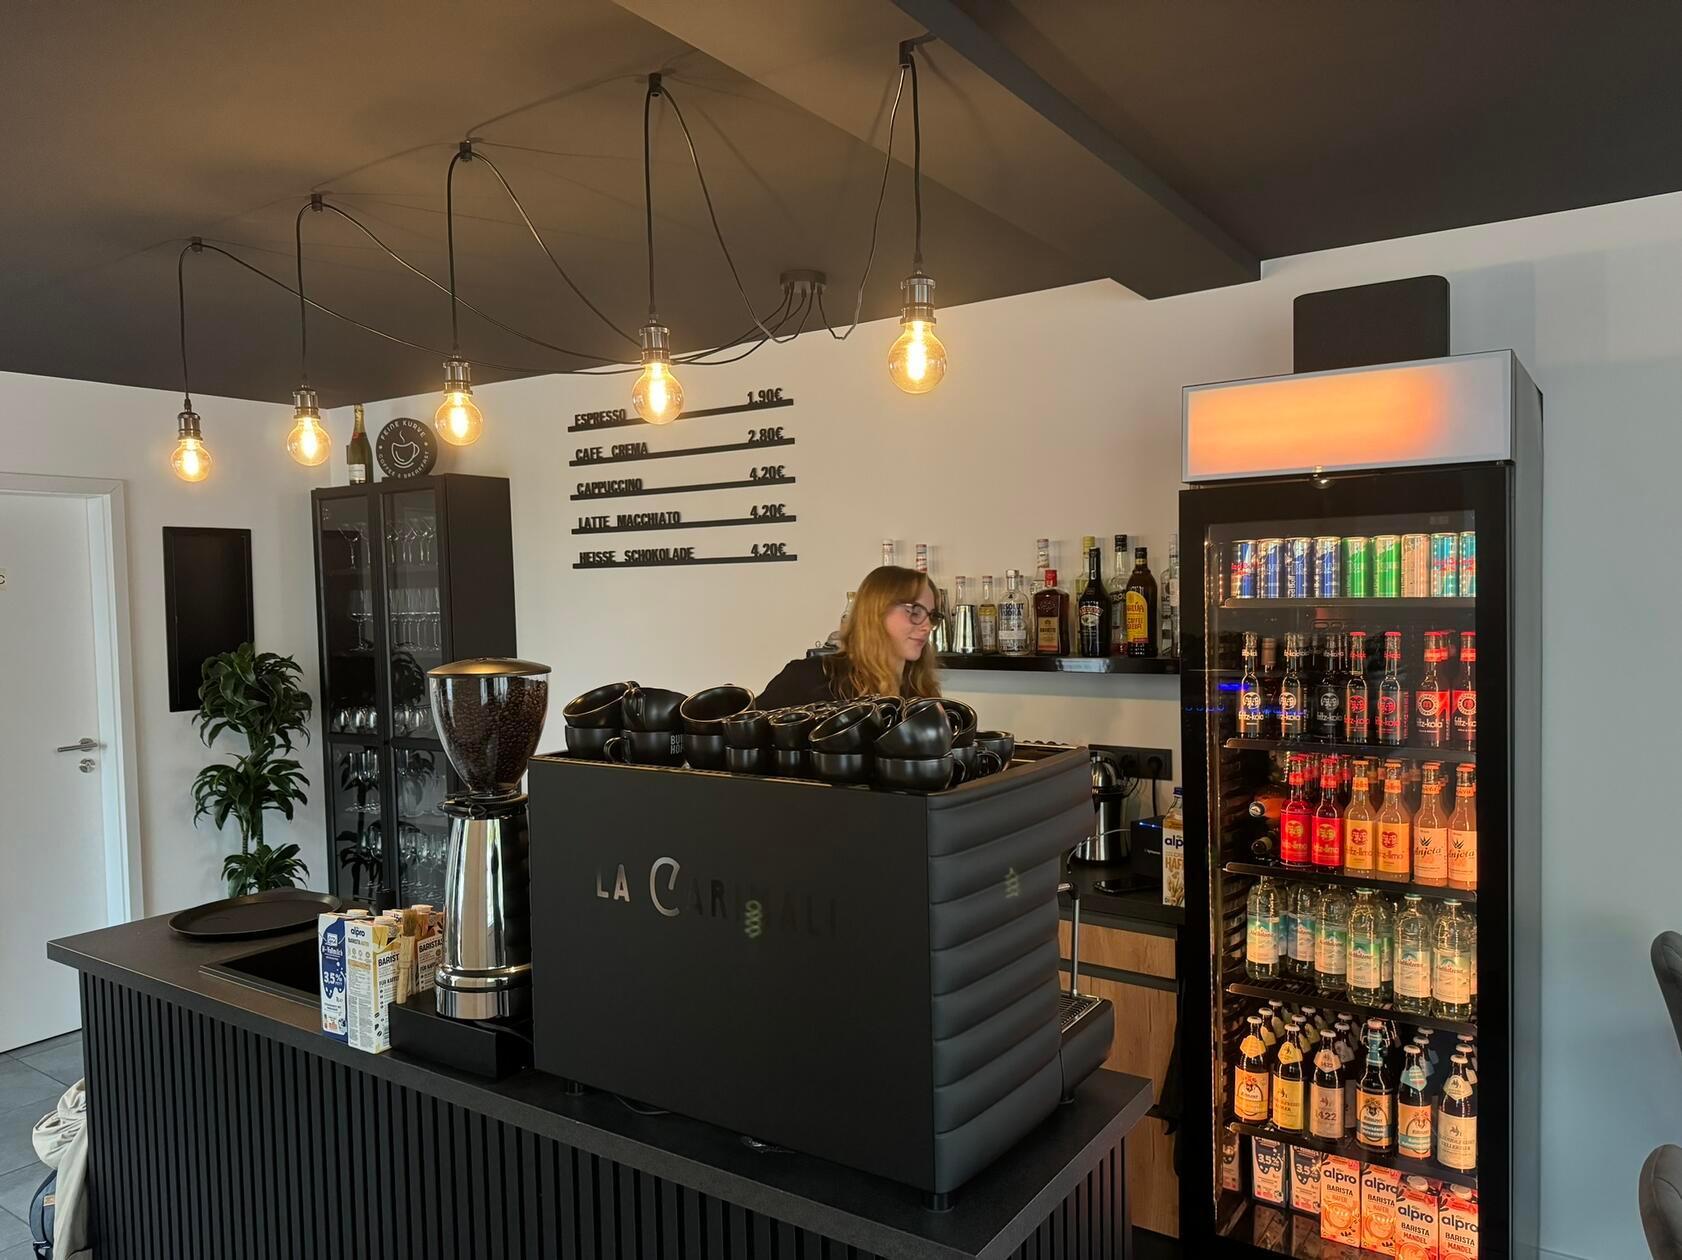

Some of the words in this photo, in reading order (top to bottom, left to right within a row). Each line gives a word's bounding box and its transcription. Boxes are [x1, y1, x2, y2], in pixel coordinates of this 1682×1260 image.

[575, 408, 627, 426] ESPRESSO
[748, 388, 784, 404] 1.90€
[381, 421, 399, 440] FEINE
[403, 420, 426, 438] KURVE
[575, 447, 603, 460] CAFE
[611, 442, 648, 458] CREMA
[748, 426, 784, 443] 2.80€
[576, 478, 643, 495] CAPPUCCINO
[749, 465, 785, 481] 4.20€
[578, 515, 610, 529] LATTE
[617, 511, 681, 527] MACCHIATO
[750, 503, 786, 519] 4.20€
[579, 550, 616, 564] HEISSE
[624, 547, 695, 562] SCHOKOLADE
[750, 542, 786, 557] 4.20€
[596, 863, 631, 903] LA
[350, 927, 365, 937] alpro
[1323, 1168, 1357, 1184] alpro
[1326, 1184, 1354, 1196] BARISTA
[1364, 1177, 1399, 1195] alpro
[1367, 1194, 1395, 1207] BARISTA
[1397, 1205, 1434, 1223] alpro
[1401, 1222, 1430, 1236] BARISTA
[1441, 1214, 1478, 1233] alpro
[1403, 1232, 1428, 1244] MANDEL
[1445, 1232, 1475, 1246] BARISTA
[1447, 1242, 1473, 1255] MANDEL
